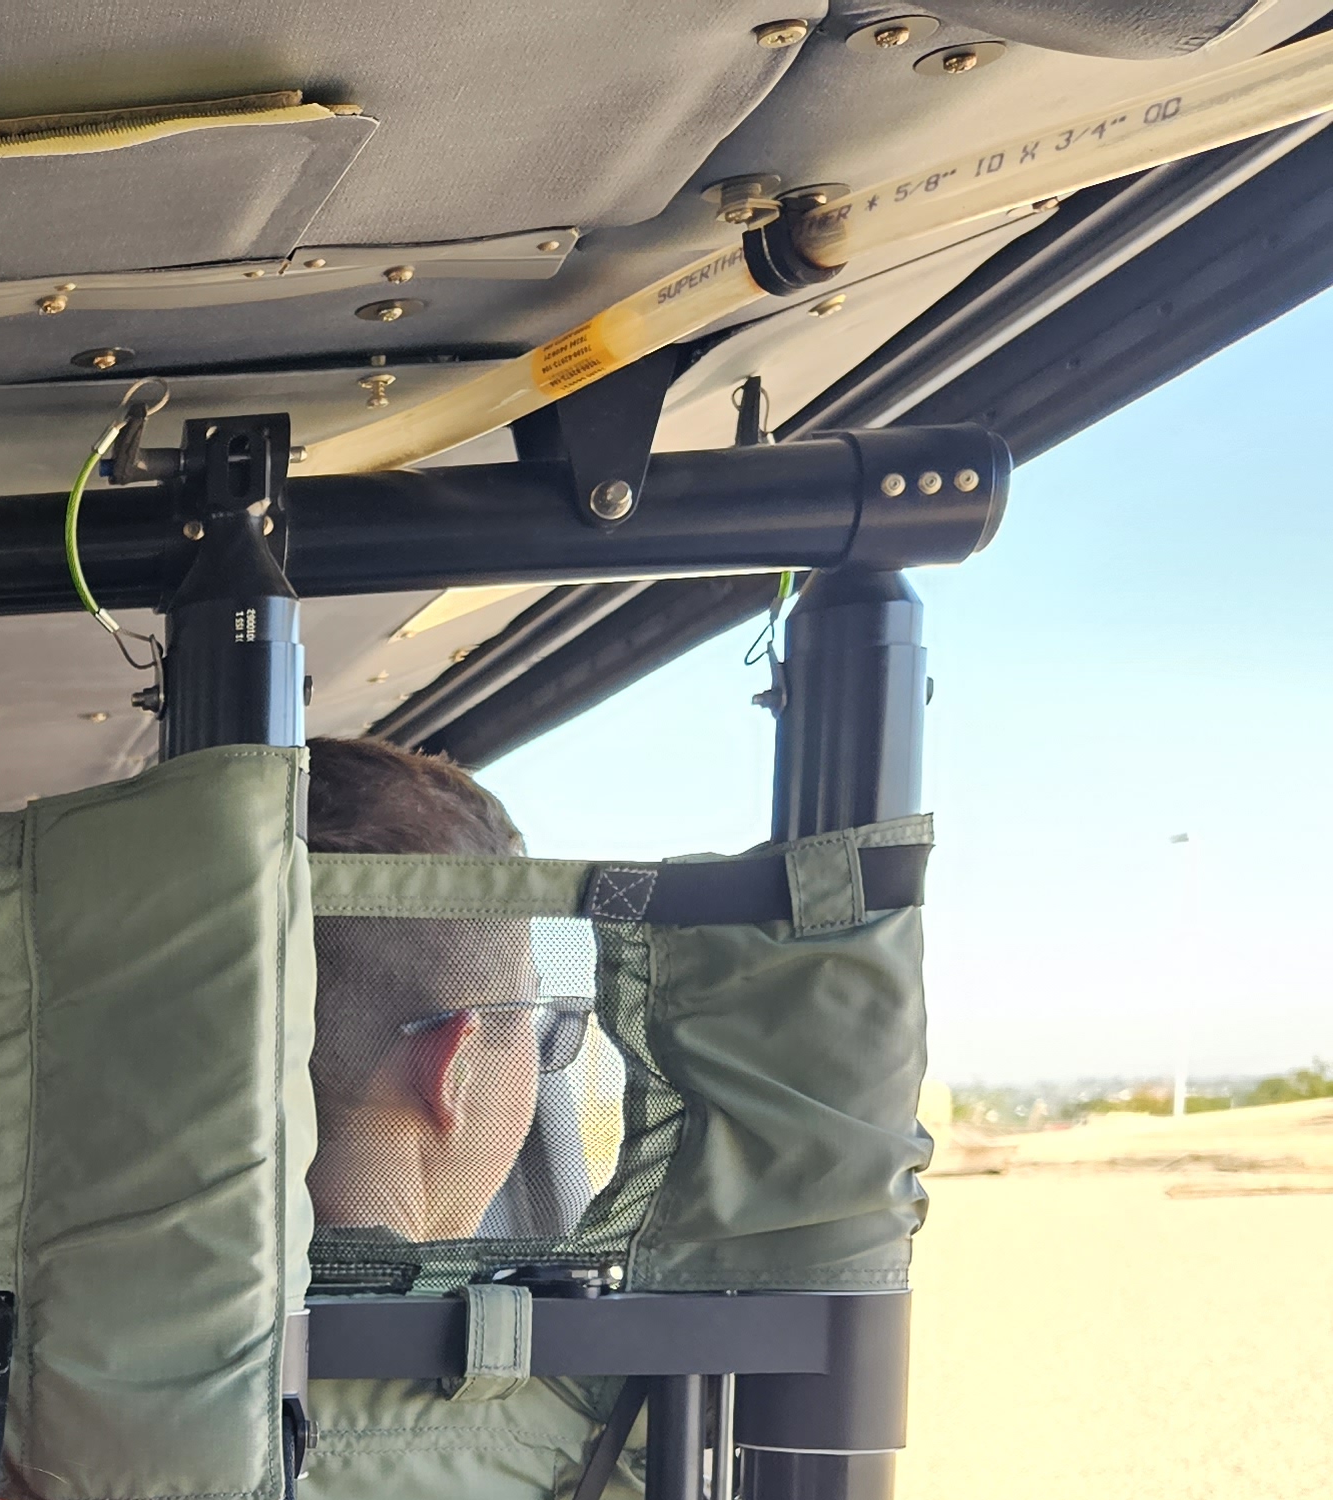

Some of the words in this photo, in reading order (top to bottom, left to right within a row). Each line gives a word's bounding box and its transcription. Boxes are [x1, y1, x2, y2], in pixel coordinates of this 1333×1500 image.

[657, 247, 745, 304] SUPERTHA
[975, 152, 1005, 178] ID
[1142, 96, 1183, 125] OD
